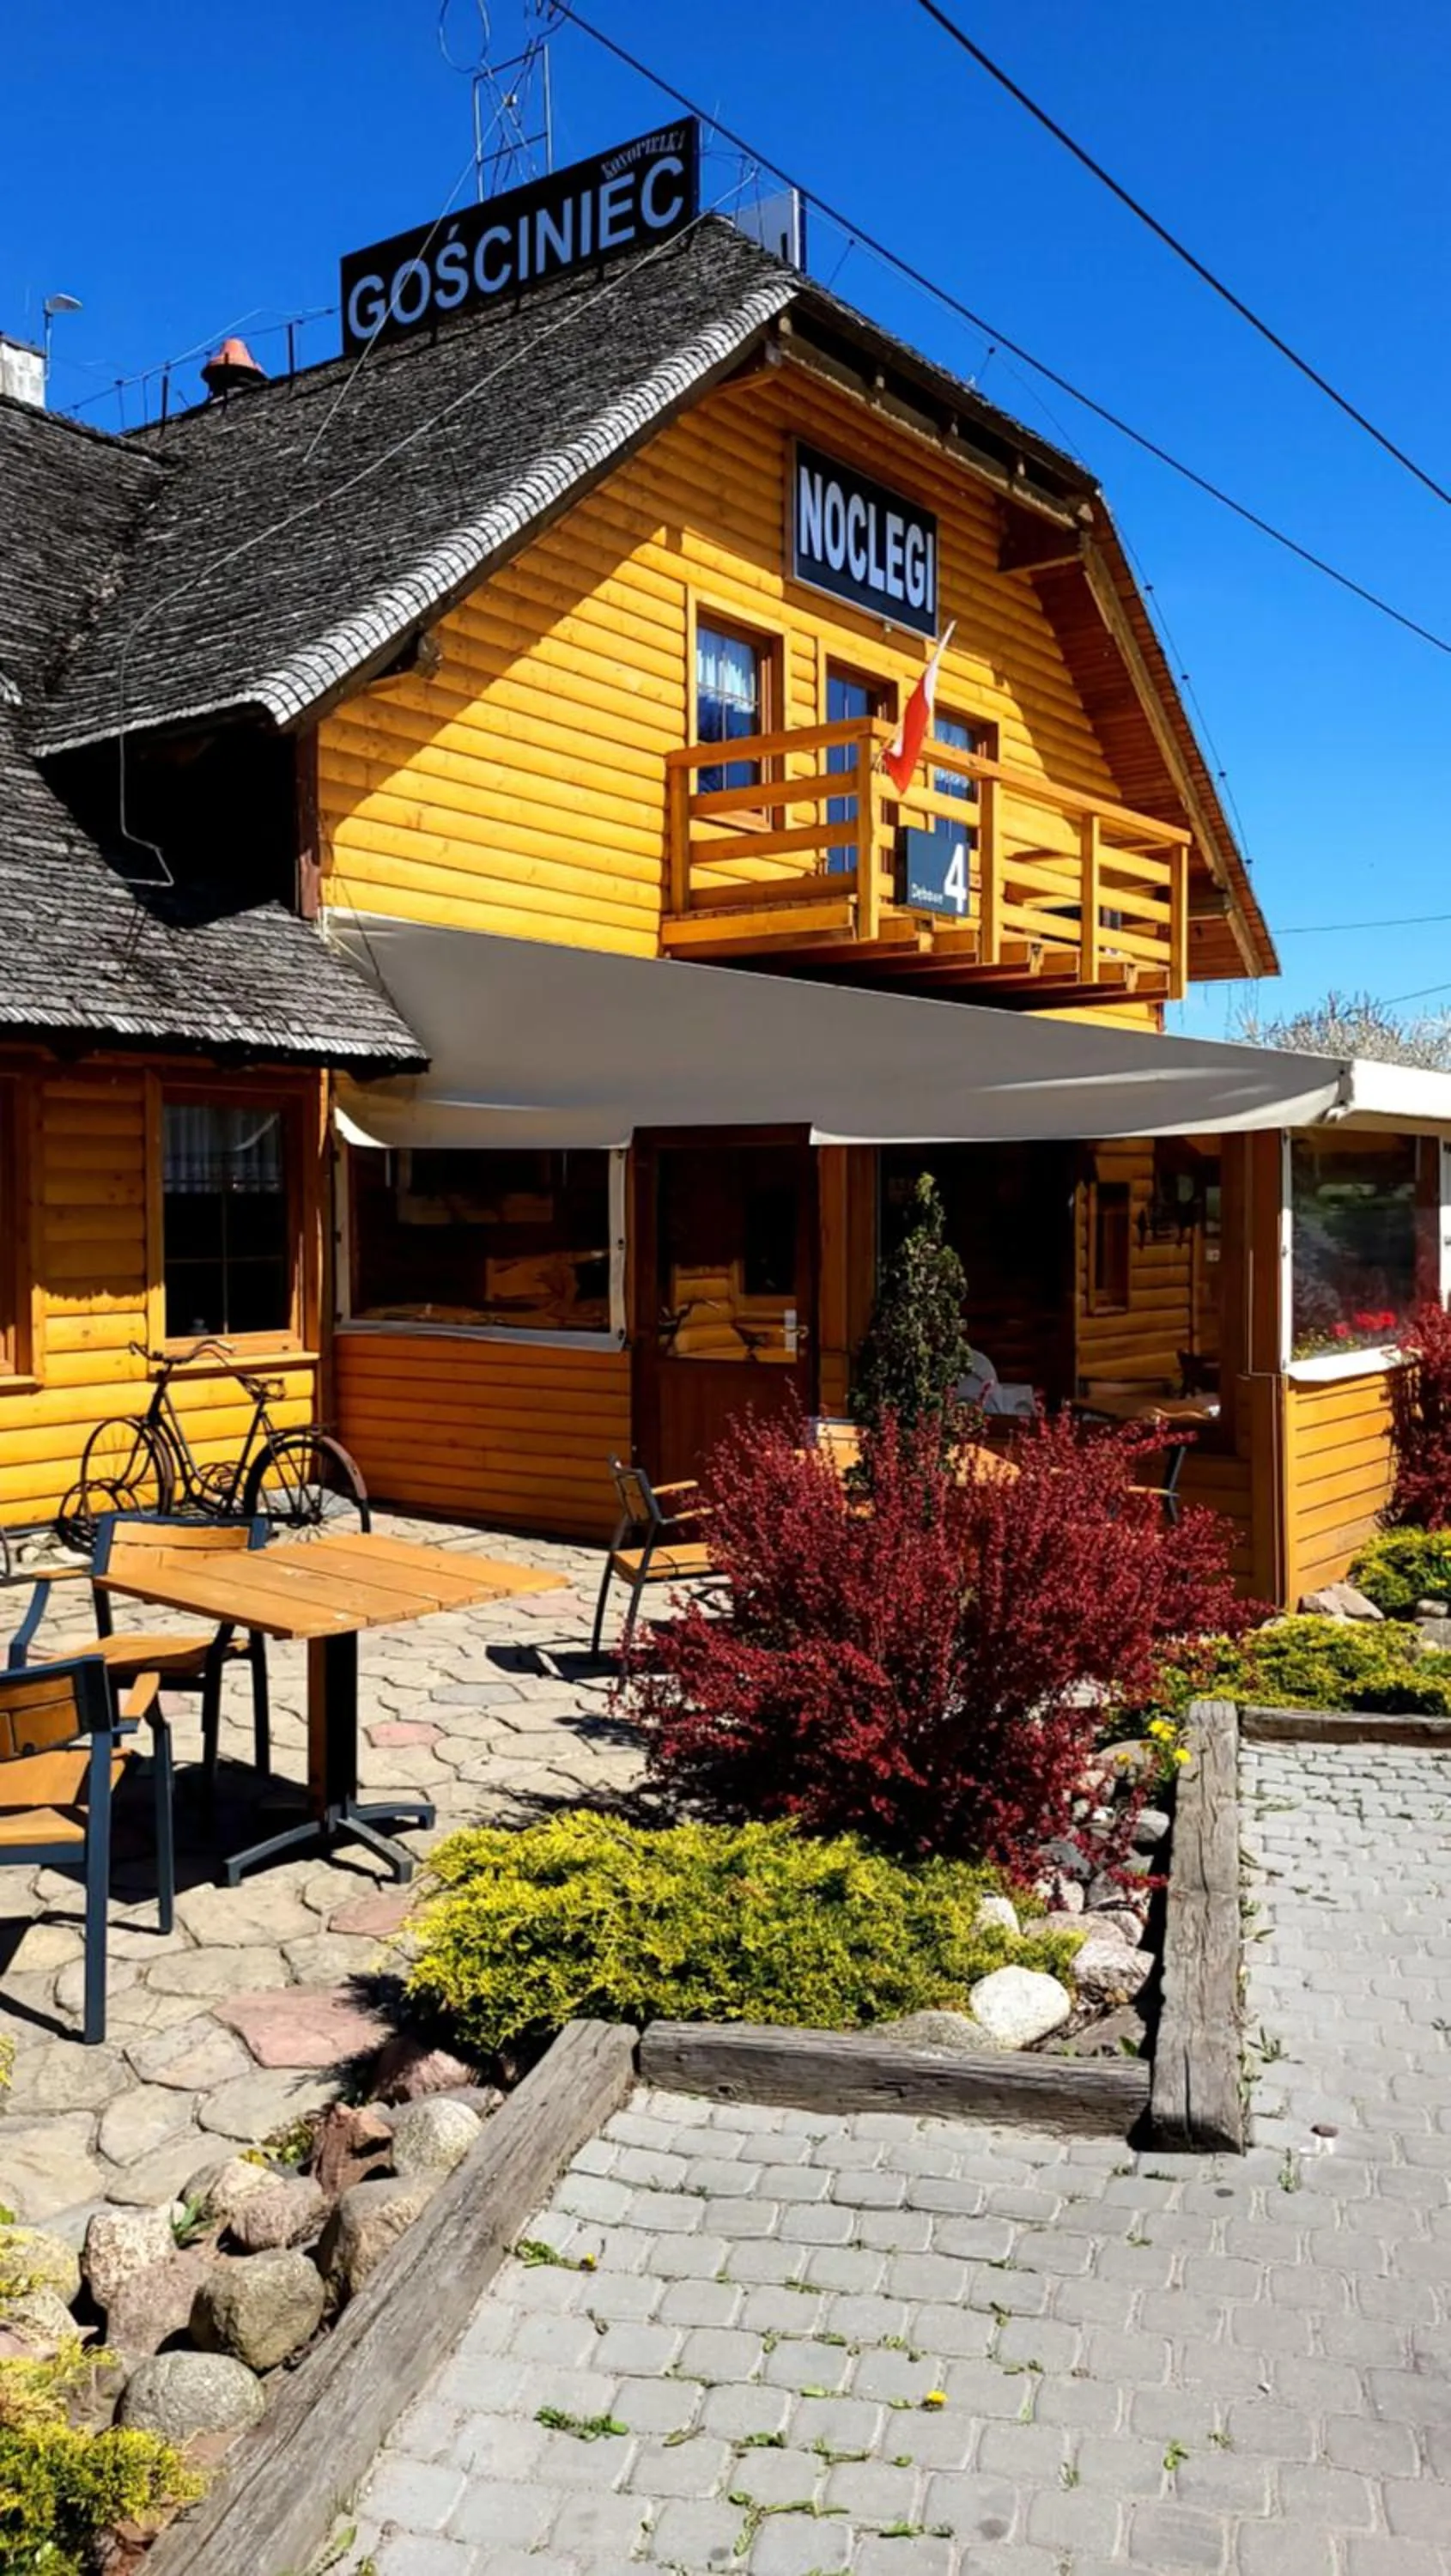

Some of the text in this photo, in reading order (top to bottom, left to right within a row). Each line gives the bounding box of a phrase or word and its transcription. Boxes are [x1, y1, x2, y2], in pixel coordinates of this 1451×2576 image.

[348, 155, 684, 340] GOŚCINIEC
[799, 465, 934, 614] NOCLEGI
[944, 843, 967, 913] 4
